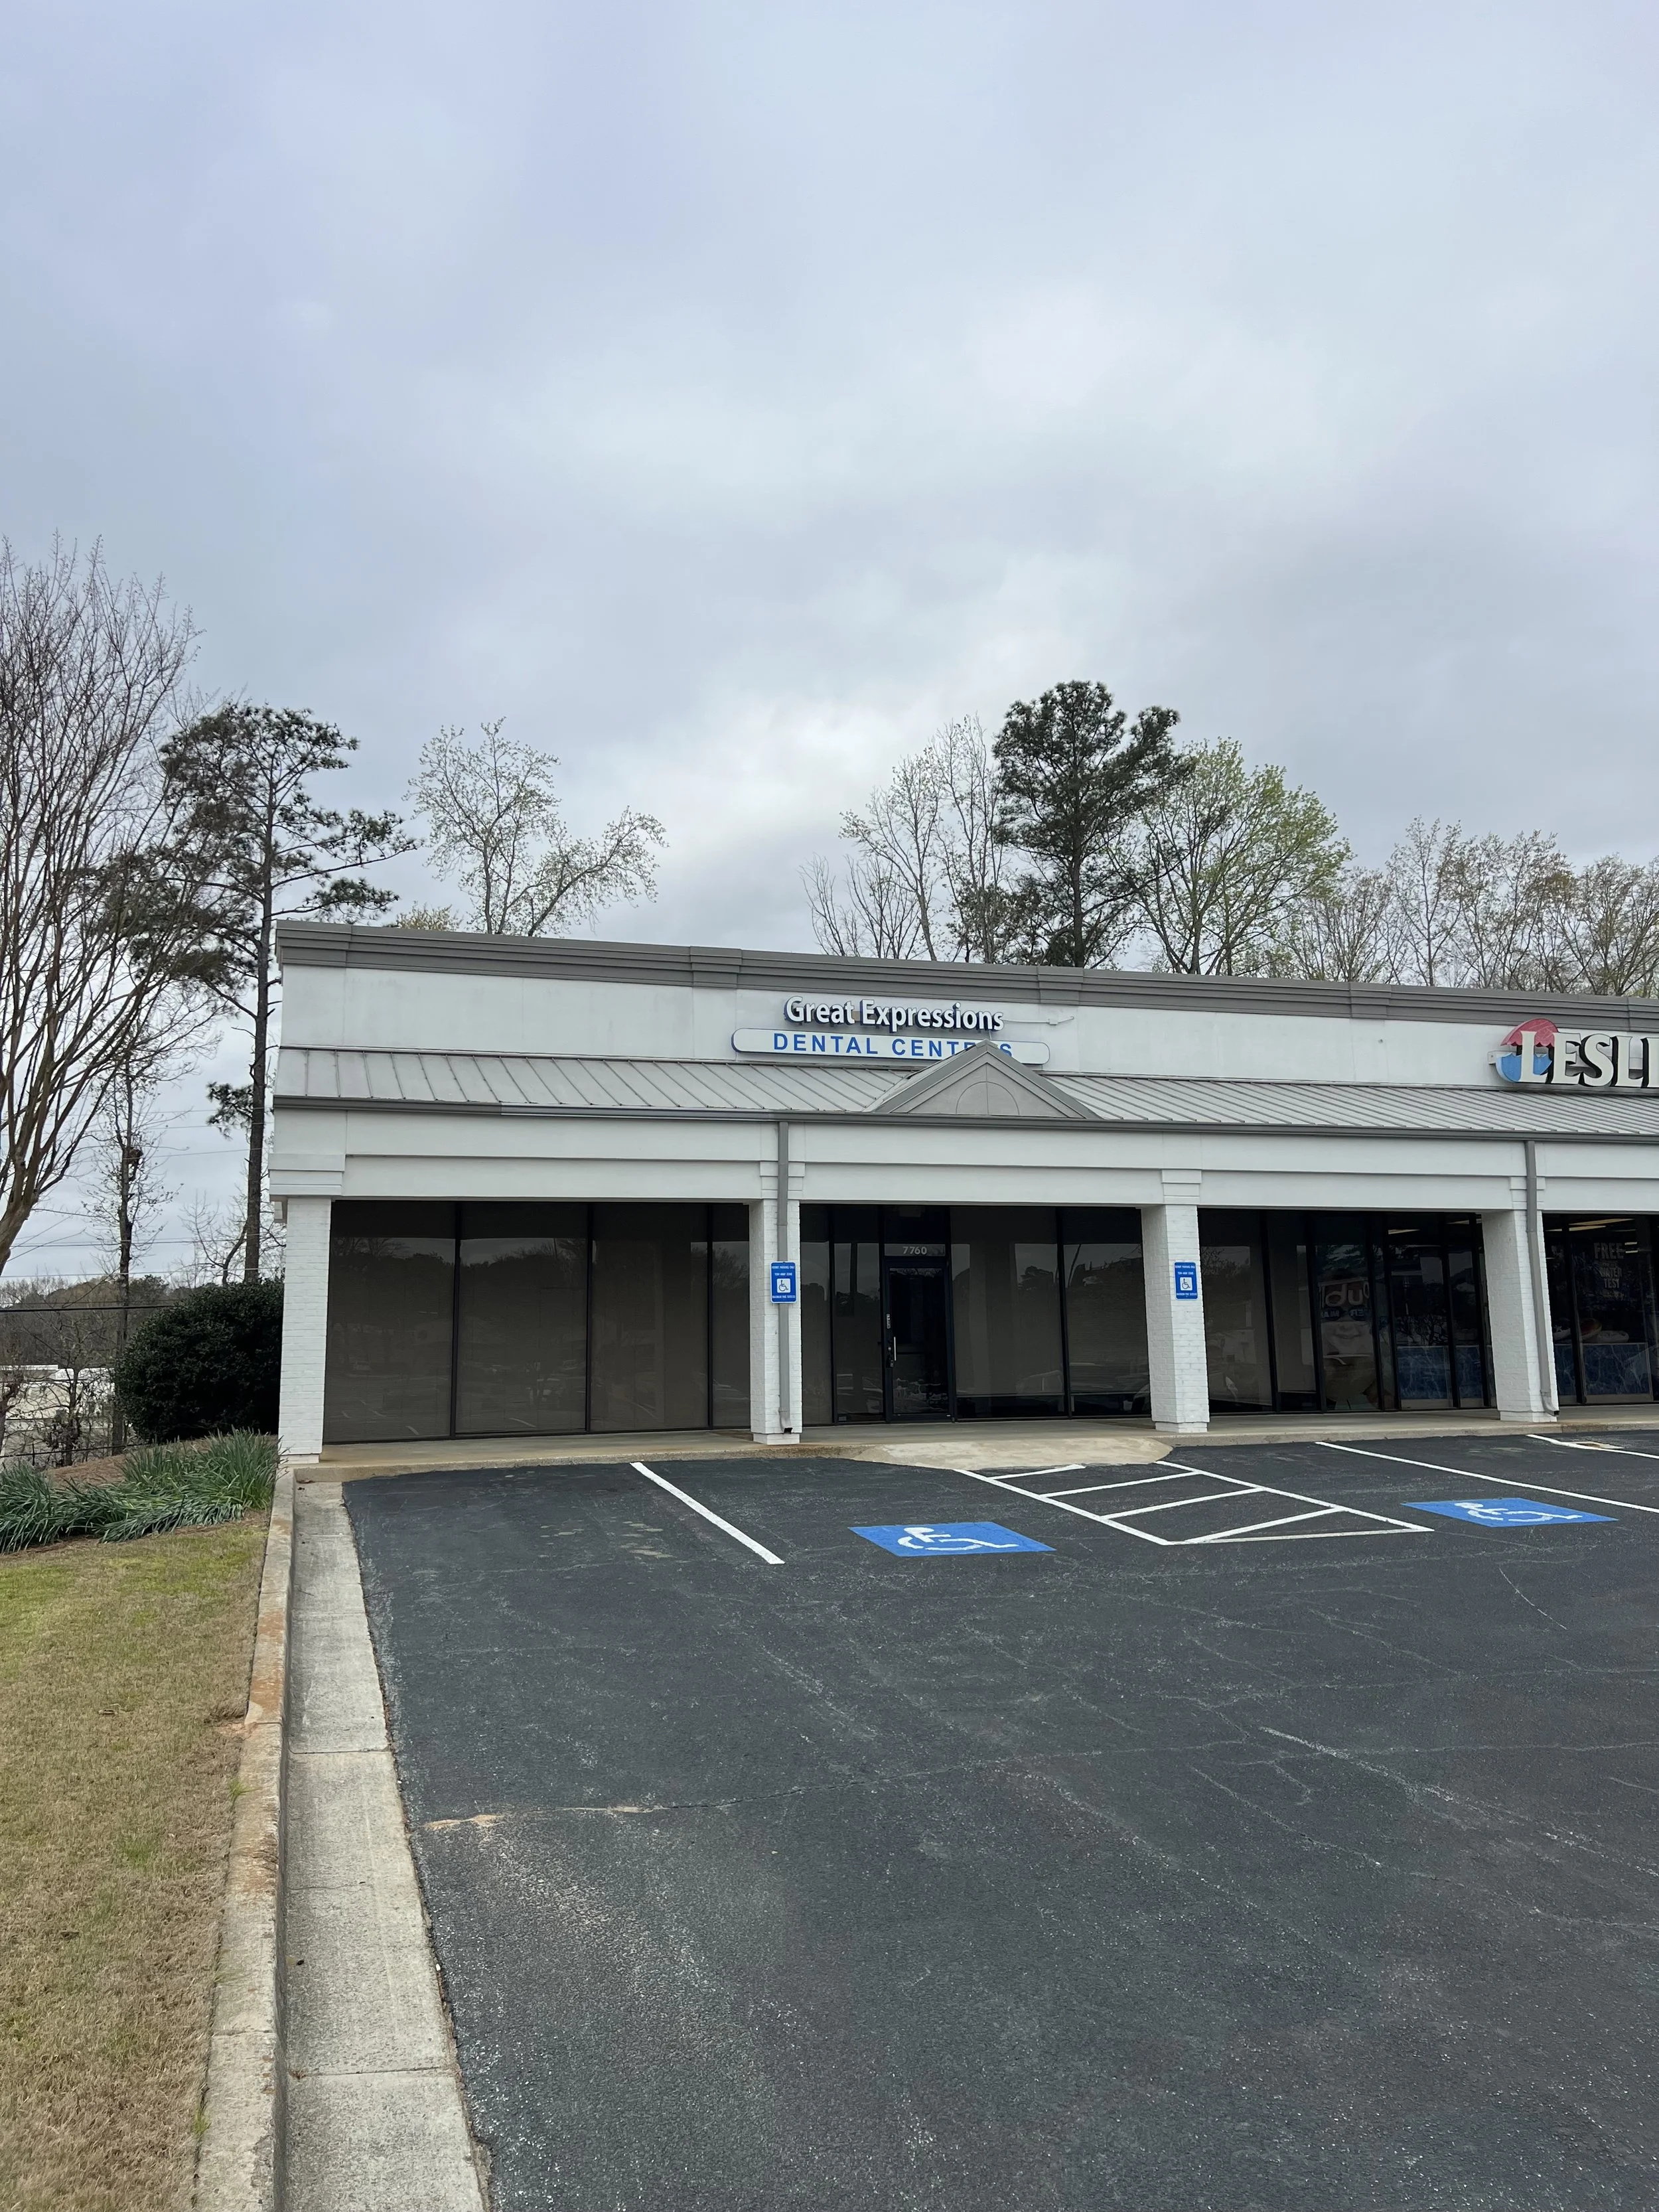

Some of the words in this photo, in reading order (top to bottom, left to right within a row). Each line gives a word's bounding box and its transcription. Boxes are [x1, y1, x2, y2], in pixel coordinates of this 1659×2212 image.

[786, 996, 855, 1025] Great
[861, 999, 1005, 1033] Expressions
[774, 1033, 878, 1054] DENTAL
[892, 1037, 1012, 1057] CENTS
[902, 1246, 928, 1255] 7760
[1593, 1242, 1624, 1259] FREE
[1604, 1278, 1619, 1288] TEST
